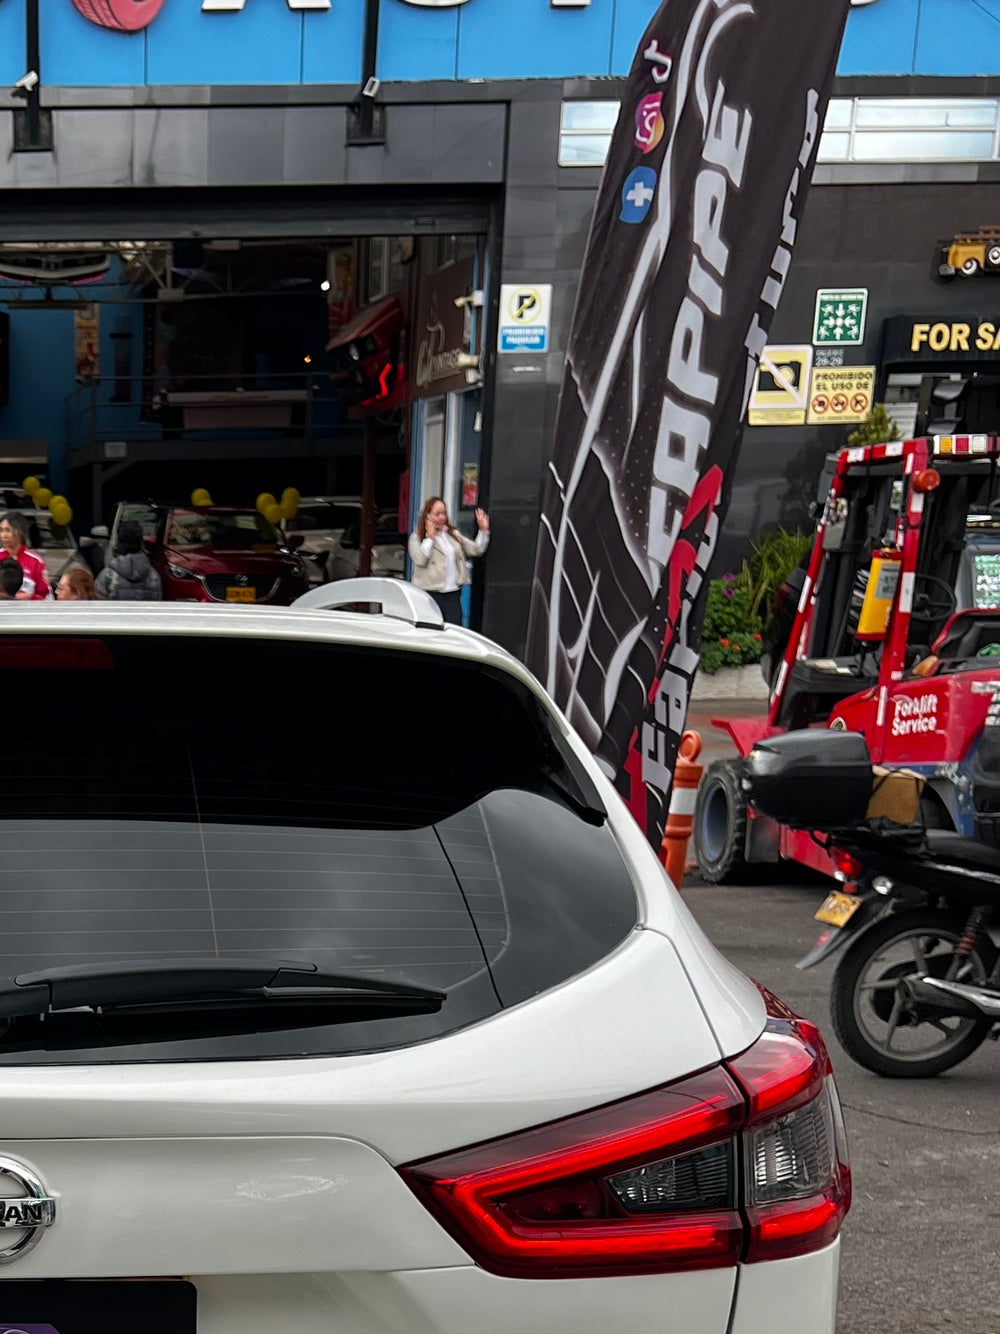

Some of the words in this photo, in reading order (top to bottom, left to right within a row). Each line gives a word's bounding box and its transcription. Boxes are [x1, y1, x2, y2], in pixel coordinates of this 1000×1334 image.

[910, 322, 971, 352] FOR
[815, 371, 873, 381] PROHIBIDO
[816, 382, 828, 391] EL
[831, 381, 853, 391] USO
[856, 381, 869, 390] DE
[894, 693, 938, 718] Forklift
[891, 716, 938, 736] Service
